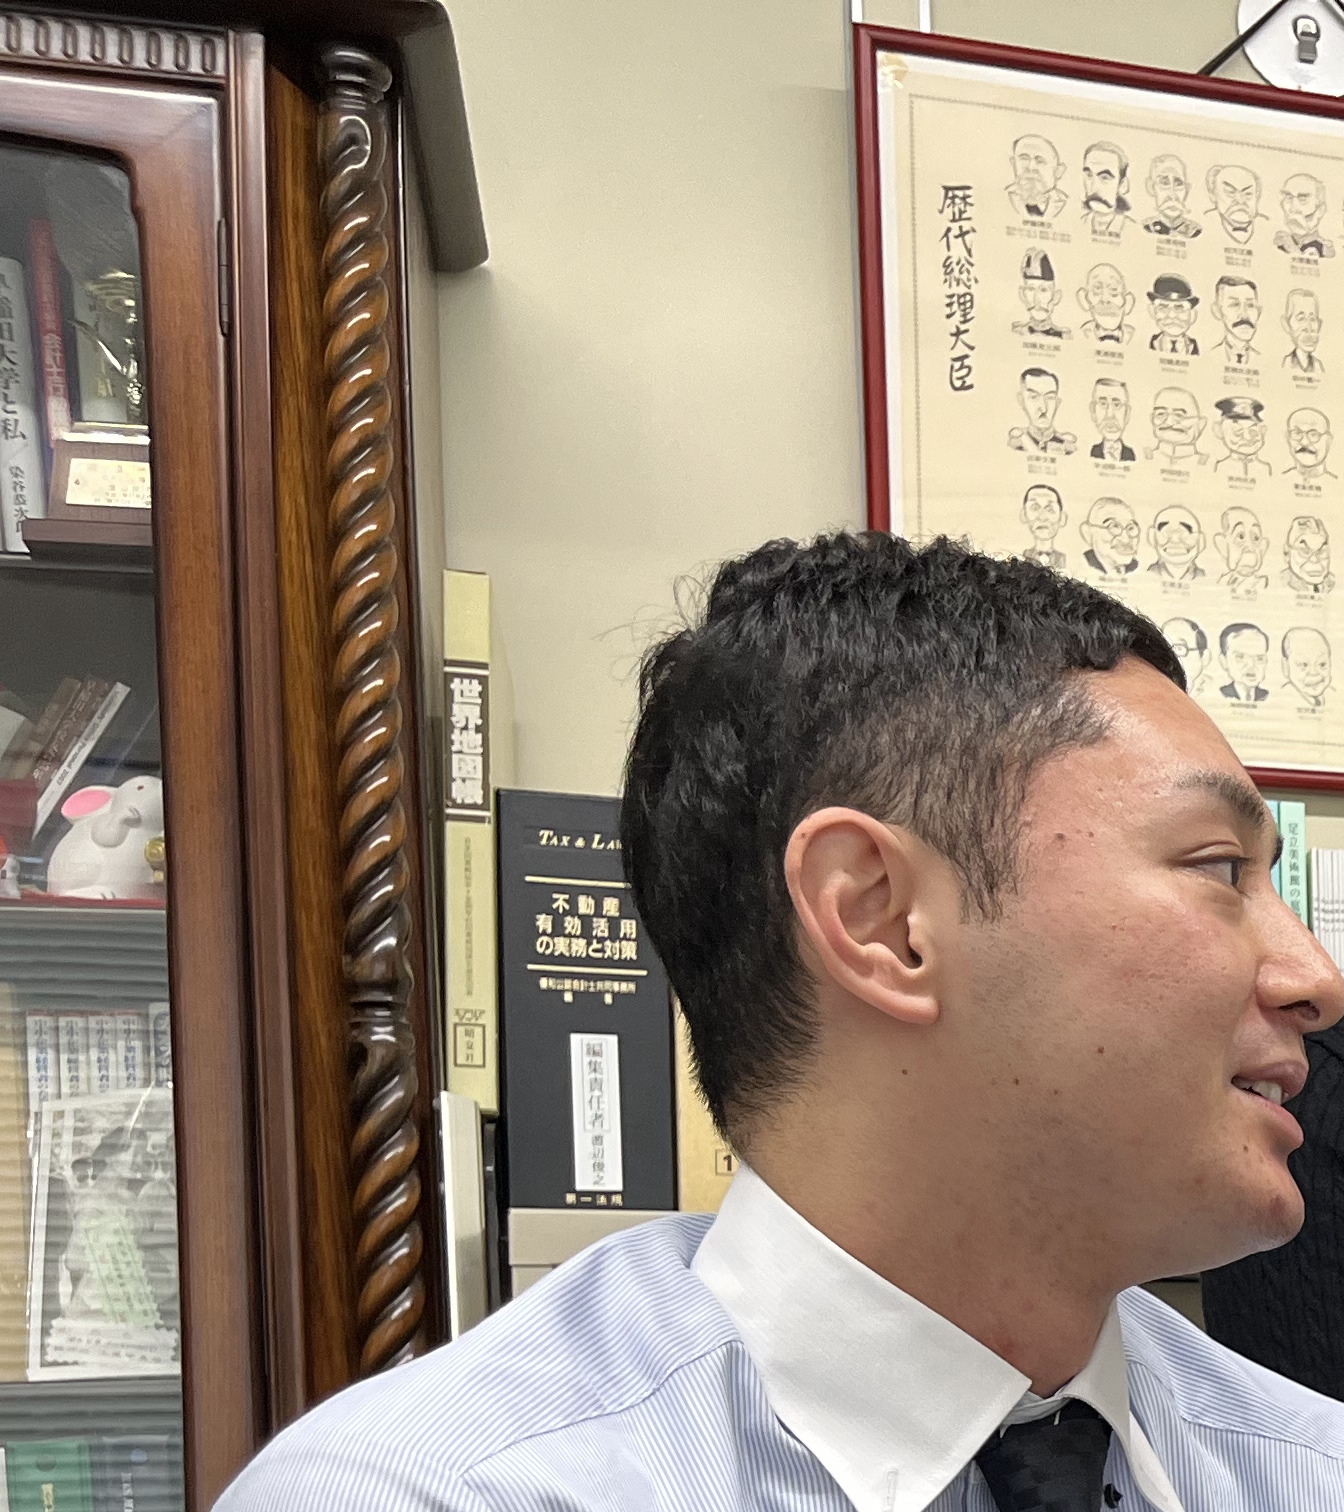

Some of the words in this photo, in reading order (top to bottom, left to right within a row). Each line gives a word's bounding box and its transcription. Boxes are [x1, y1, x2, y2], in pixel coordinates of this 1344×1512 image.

[938, 184, 979, 392] 歴代総理大臣
[538, 829, 570, 848] TAX
[574, 835, 586, 849] &
[551, 892, 621, 918] 不動産
[535, 912, 637, 939] 有効活用
[535, 935, 639, 961] の実務と対策
